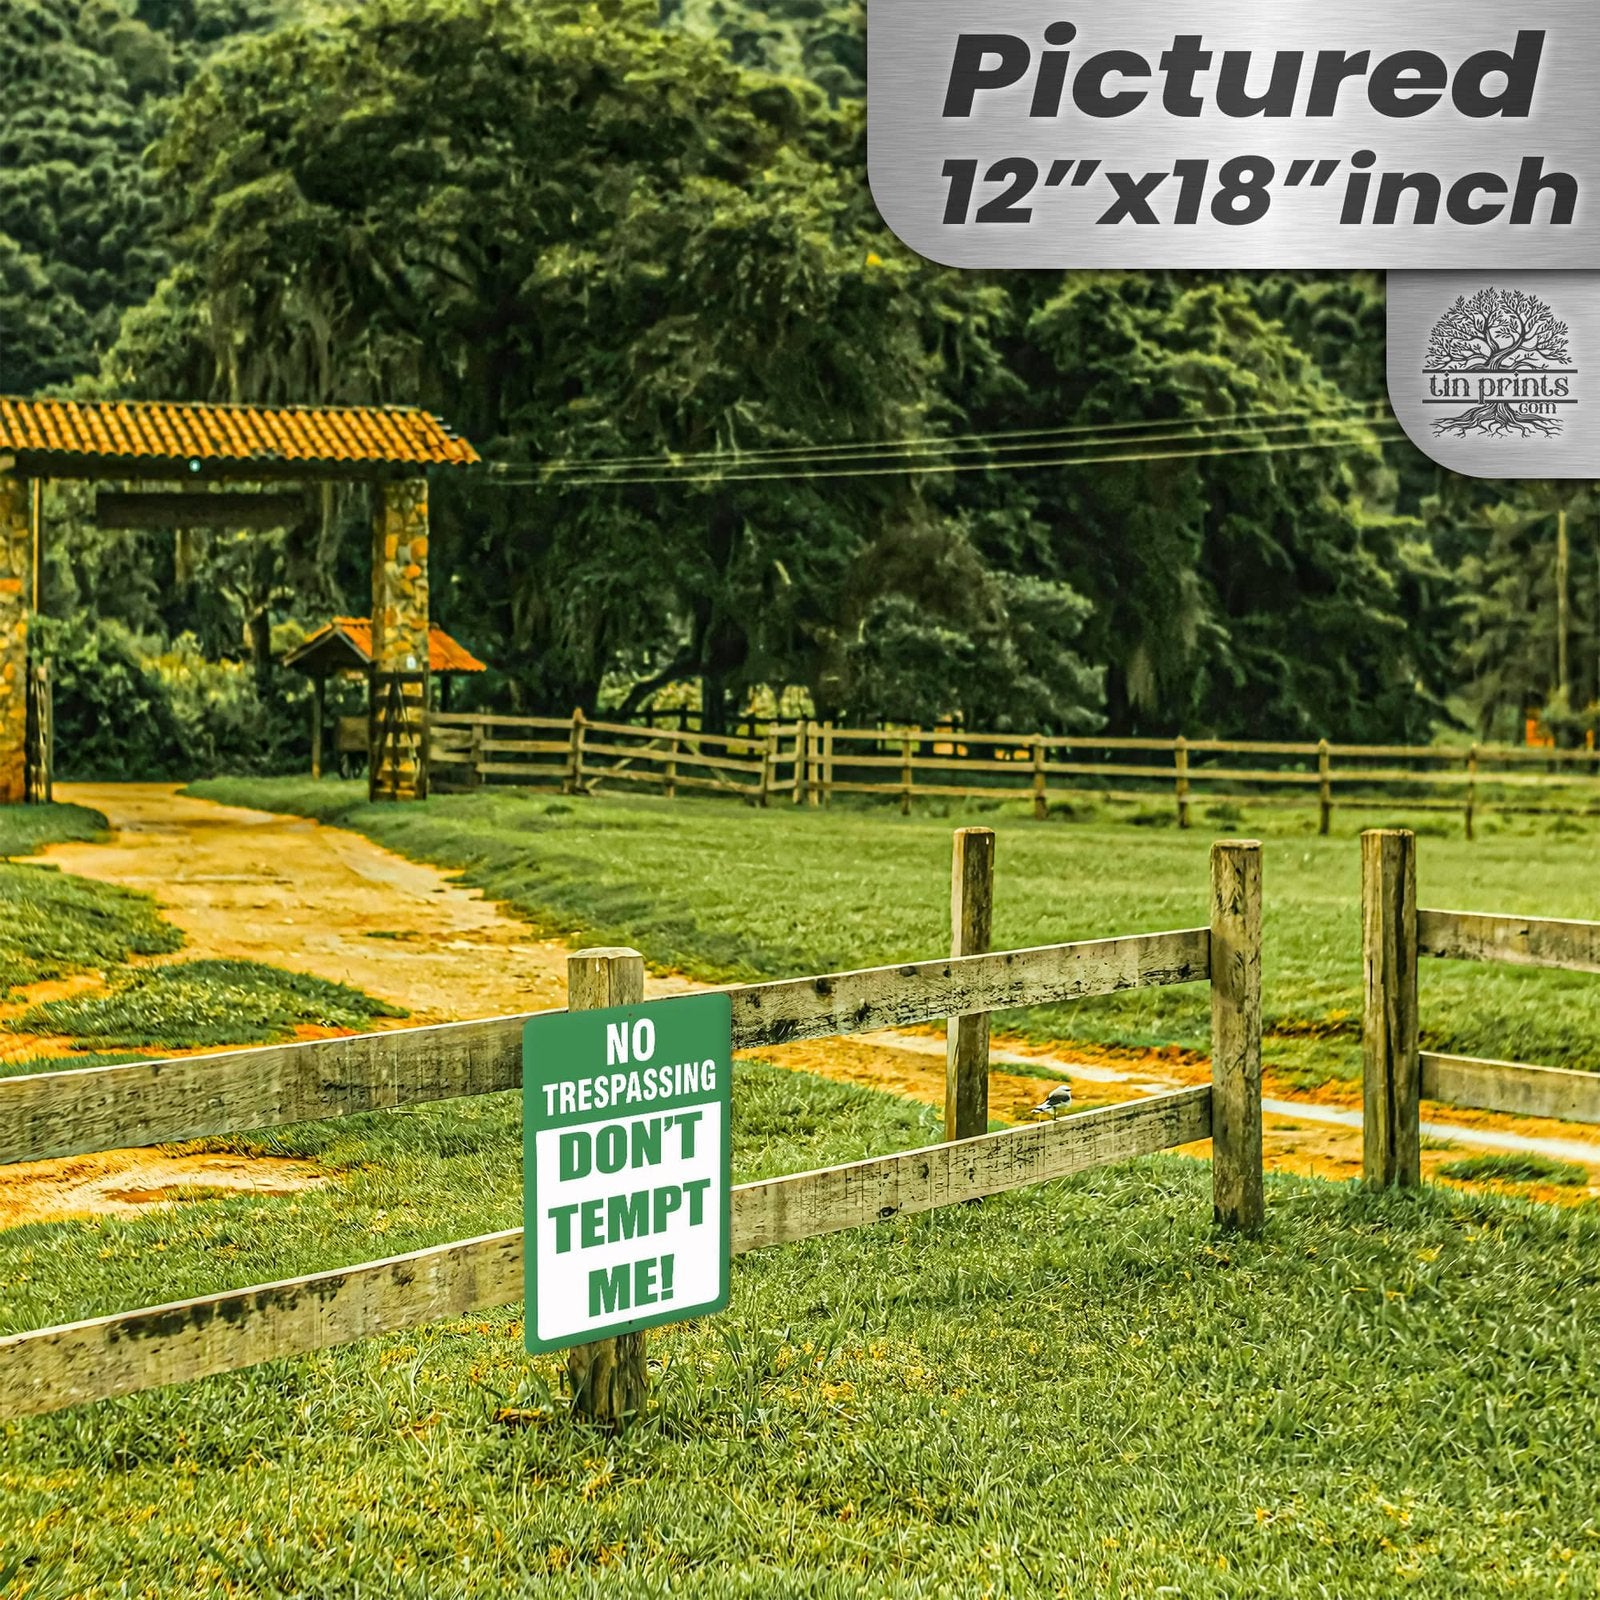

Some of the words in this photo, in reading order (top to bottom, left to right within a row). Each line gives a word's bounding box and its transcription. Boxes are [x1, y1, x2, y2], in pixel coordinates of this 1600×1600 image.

[606, 1018, 656, 1065] NO
[542, 1059, 717, 1116] TRESPASSING
[559, 1111, 703, 1182] DON'T
[548, 1178, 711, 1254] TEMPT
[588, 1253, 675, 1318] ME!
